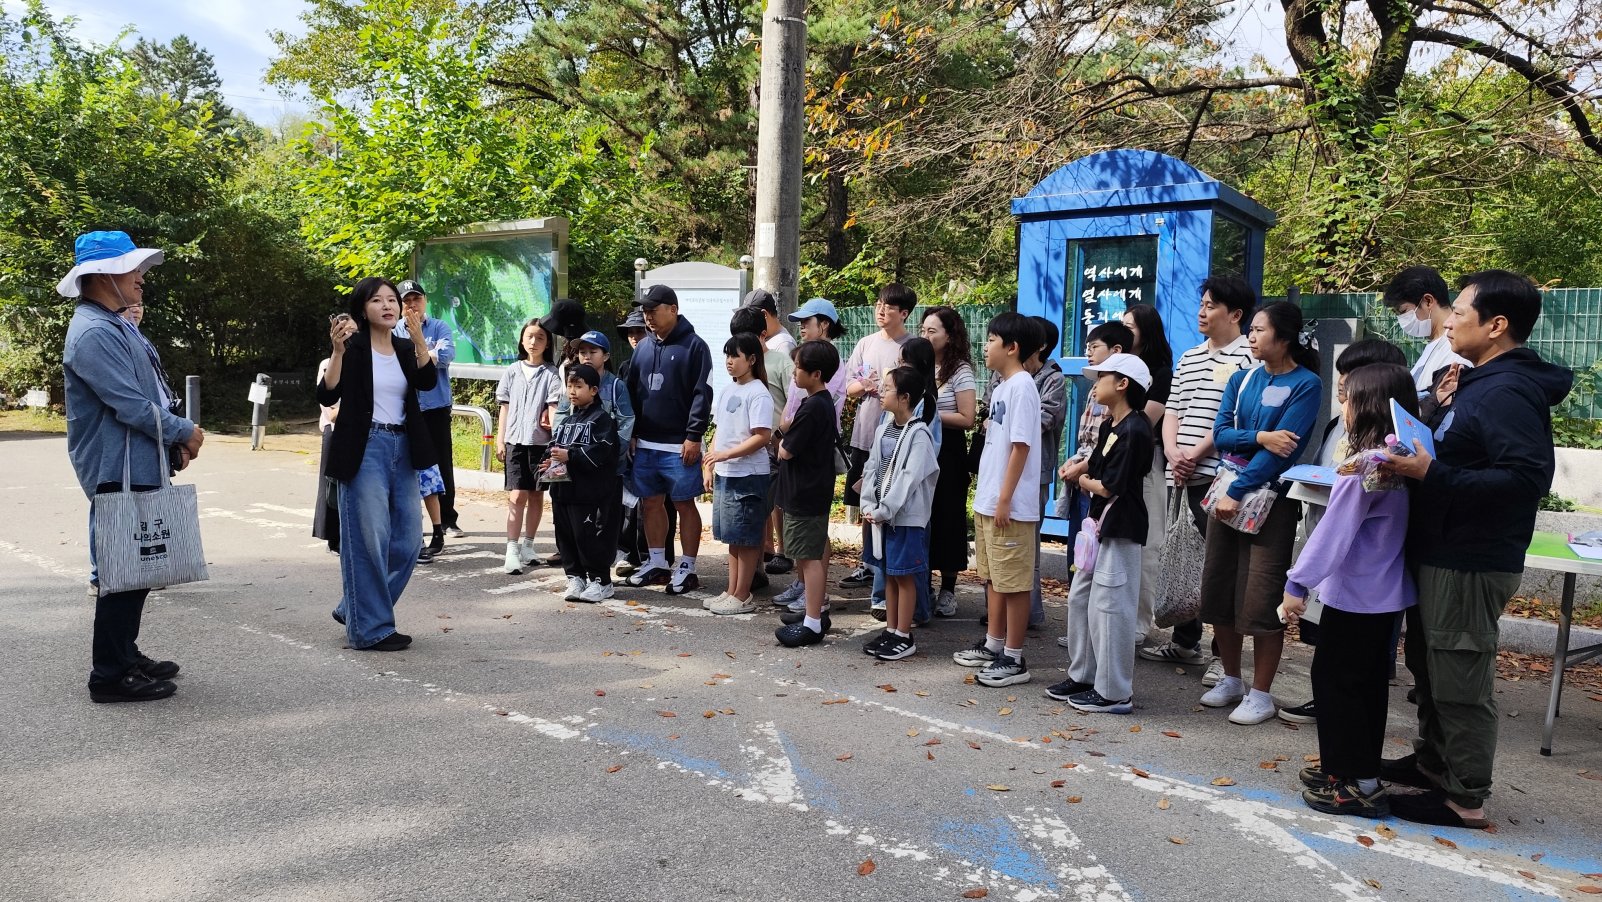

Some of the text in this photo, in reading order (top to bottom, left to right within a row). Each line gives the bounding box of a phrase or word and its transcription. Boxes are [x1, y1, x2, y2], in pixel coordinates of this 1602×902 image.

[1084, 265, 1143, 281] 역사에게
[1082, 286, 1142, 304] 열사에게
[1081, 308, 1125, 326] 동지에
[154, 519, 163, 529] 구
[140, 553, 168, 562] unesco
